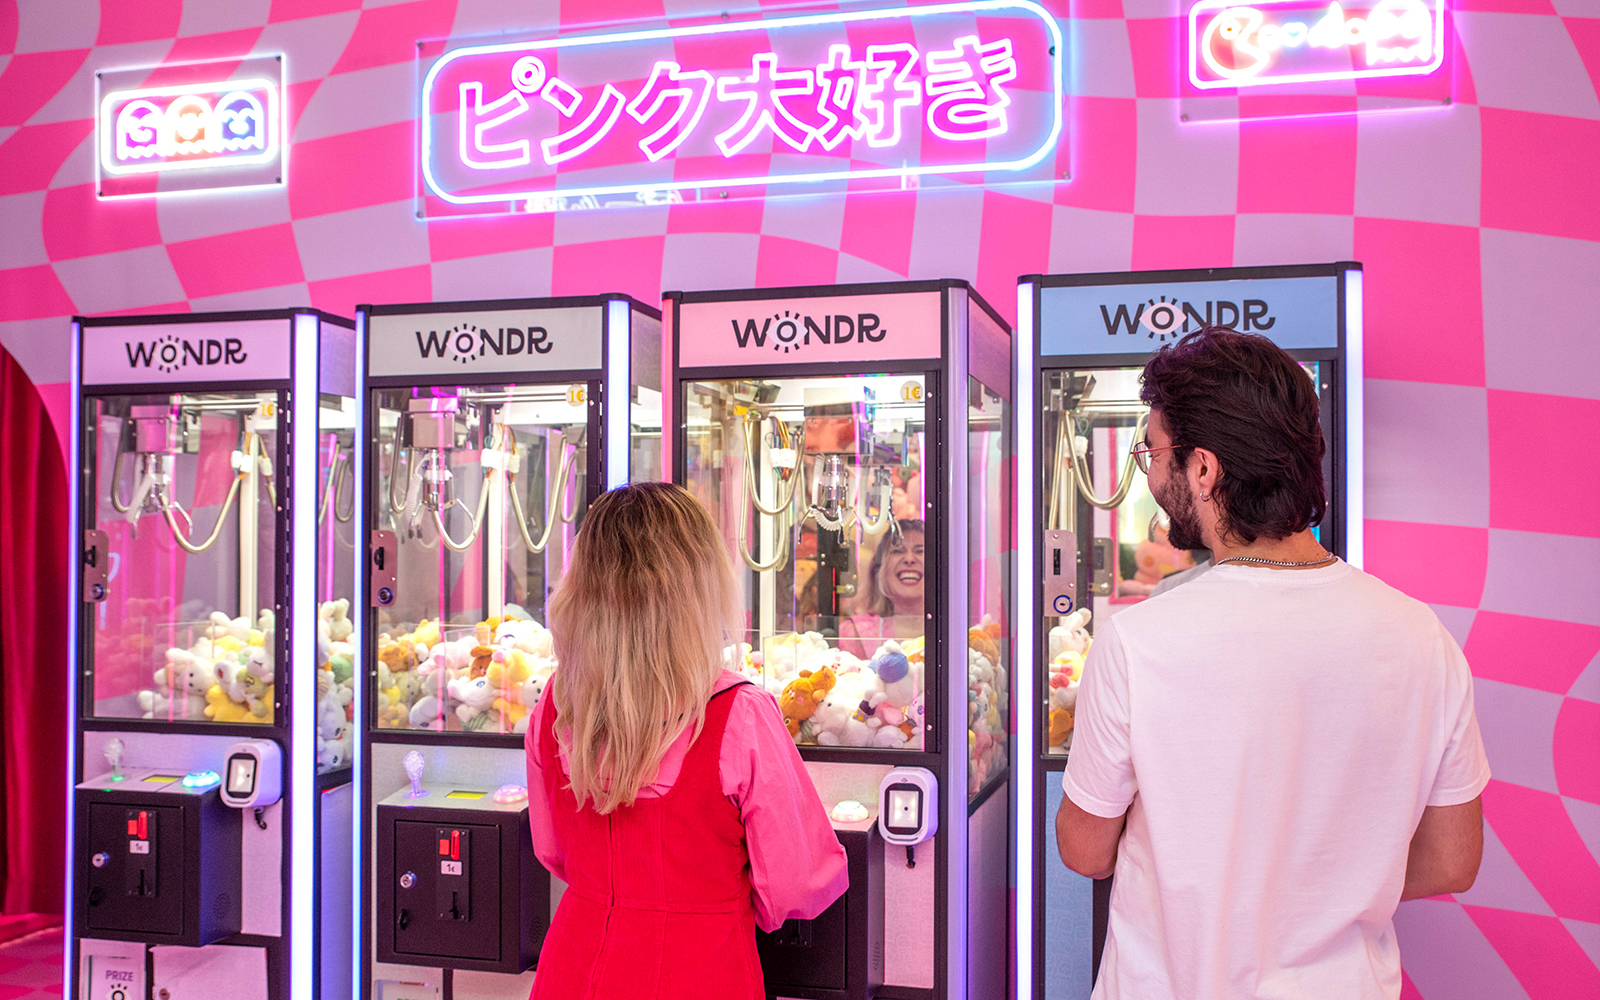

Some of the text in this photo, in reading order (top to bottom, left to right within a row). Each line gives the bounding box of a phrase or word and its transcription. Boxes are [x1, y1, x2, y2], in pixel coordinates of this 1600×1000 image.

[459, 35, 1017, 170] ピンク大好き
[731, 311, 887, 353] WONDR
[1100, 296, 1276, 341] WONDR
[125, 335, 248, 373] WONDR
[416, 323, 554, 363] WONDR
[261, 404, 274, 417] 1€
[570, 389, 585, 403] 1€
[903, 386, 921, 400] 1€
[105, 969, 135, 982] PRIZE
